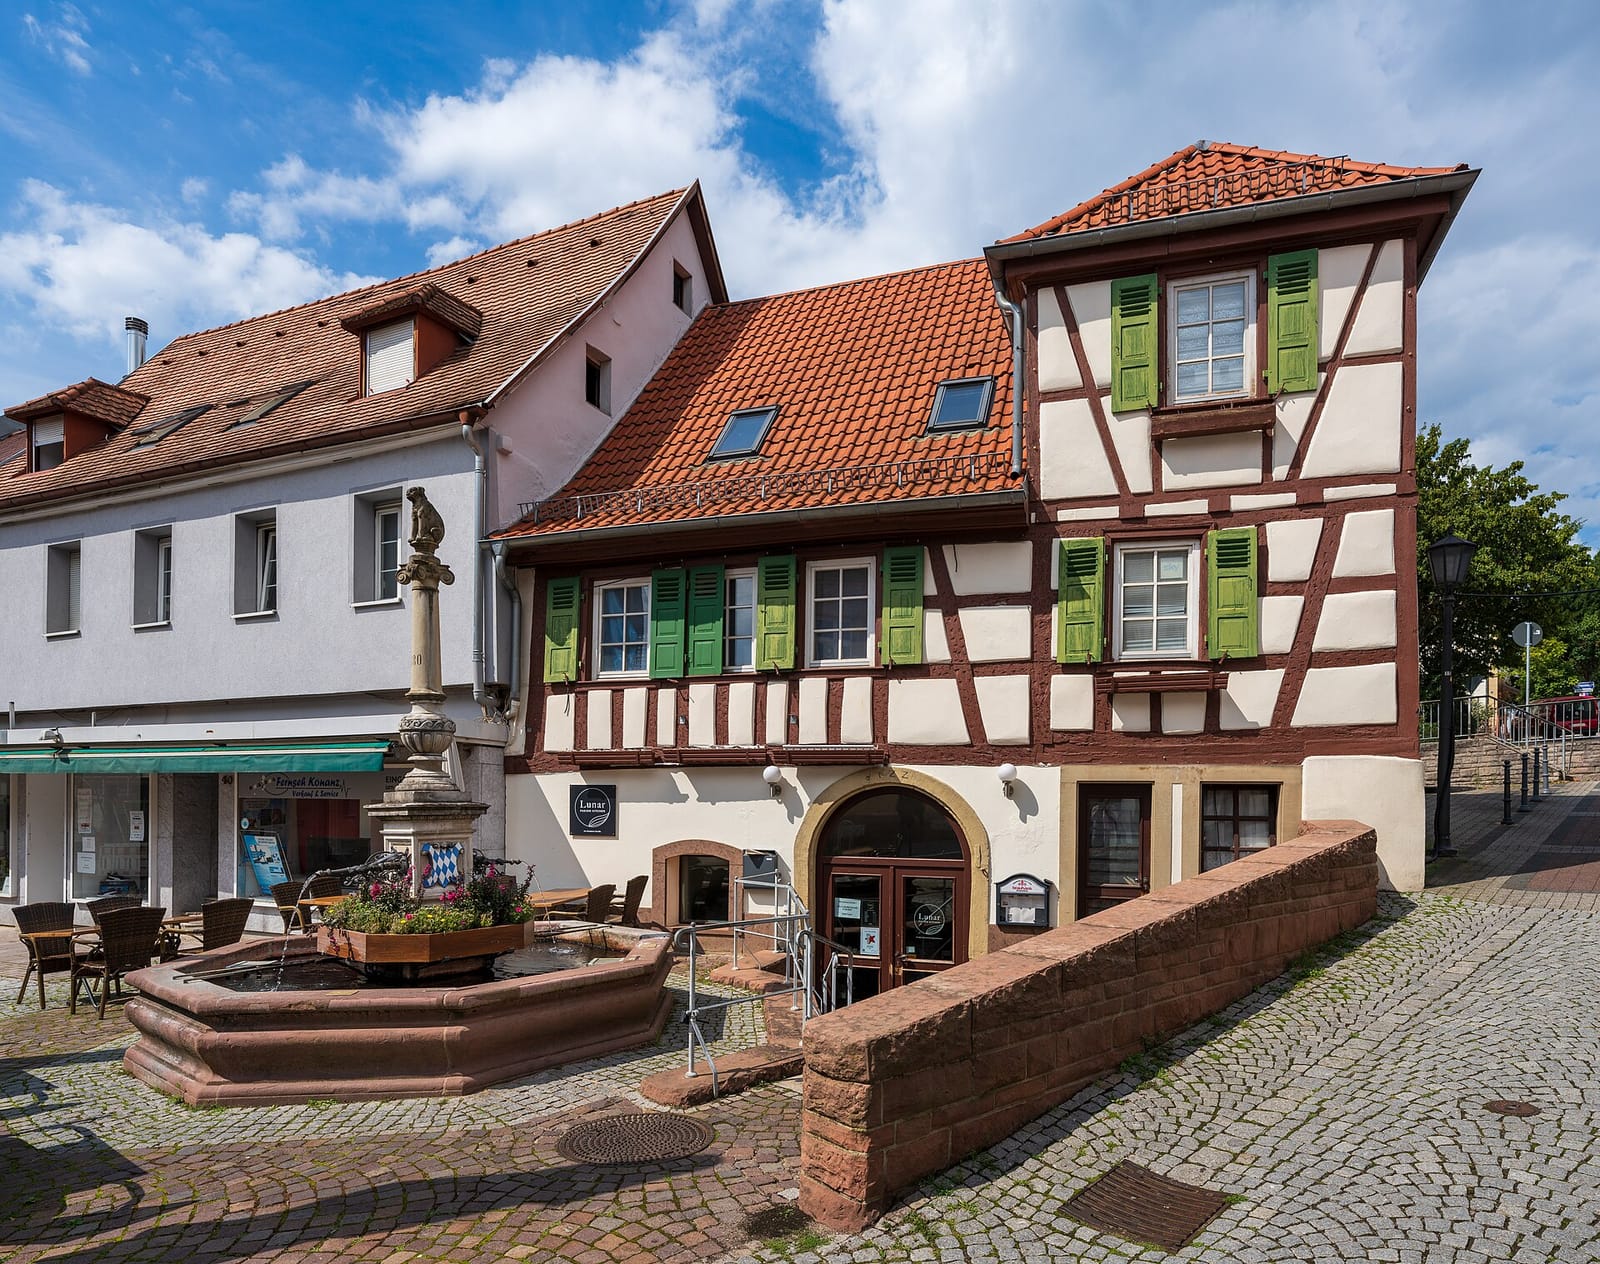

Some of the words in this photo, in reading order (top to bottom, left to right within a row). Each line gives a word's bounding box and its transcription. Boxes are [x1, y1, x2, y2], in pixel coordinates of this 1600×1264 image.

[275, 776, 306, 788] Fernseh
[308, 776, 340, 787] Konanz
[292, 790, 314, 798] Verkauf
[580, 799, 606, 809] Lunar
[918, 912, 941, 921] Lunar
